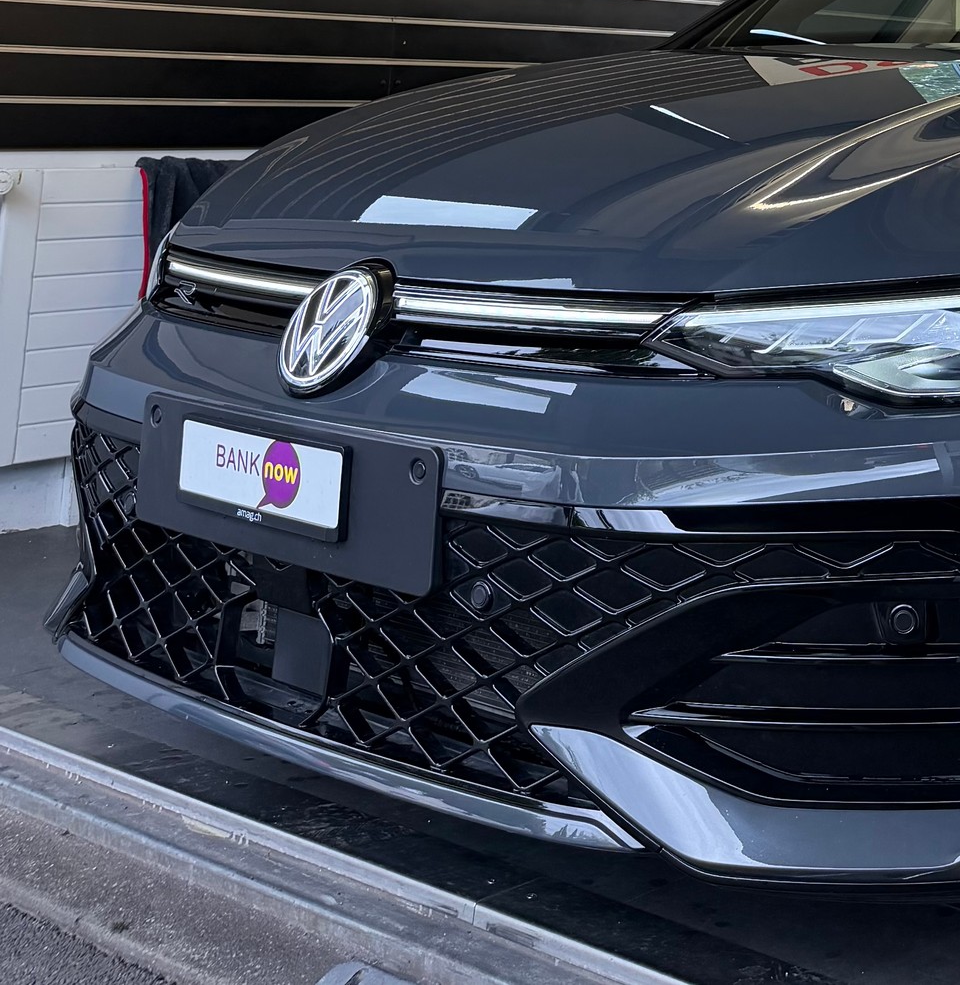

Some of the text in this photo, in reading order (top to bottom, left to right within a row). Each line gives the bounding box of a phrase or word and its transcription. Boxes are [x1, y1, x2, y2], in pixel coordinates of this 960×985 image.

[216, 443, 299, 485] BANK now
[236, 508, 262, 522] amag.ch
